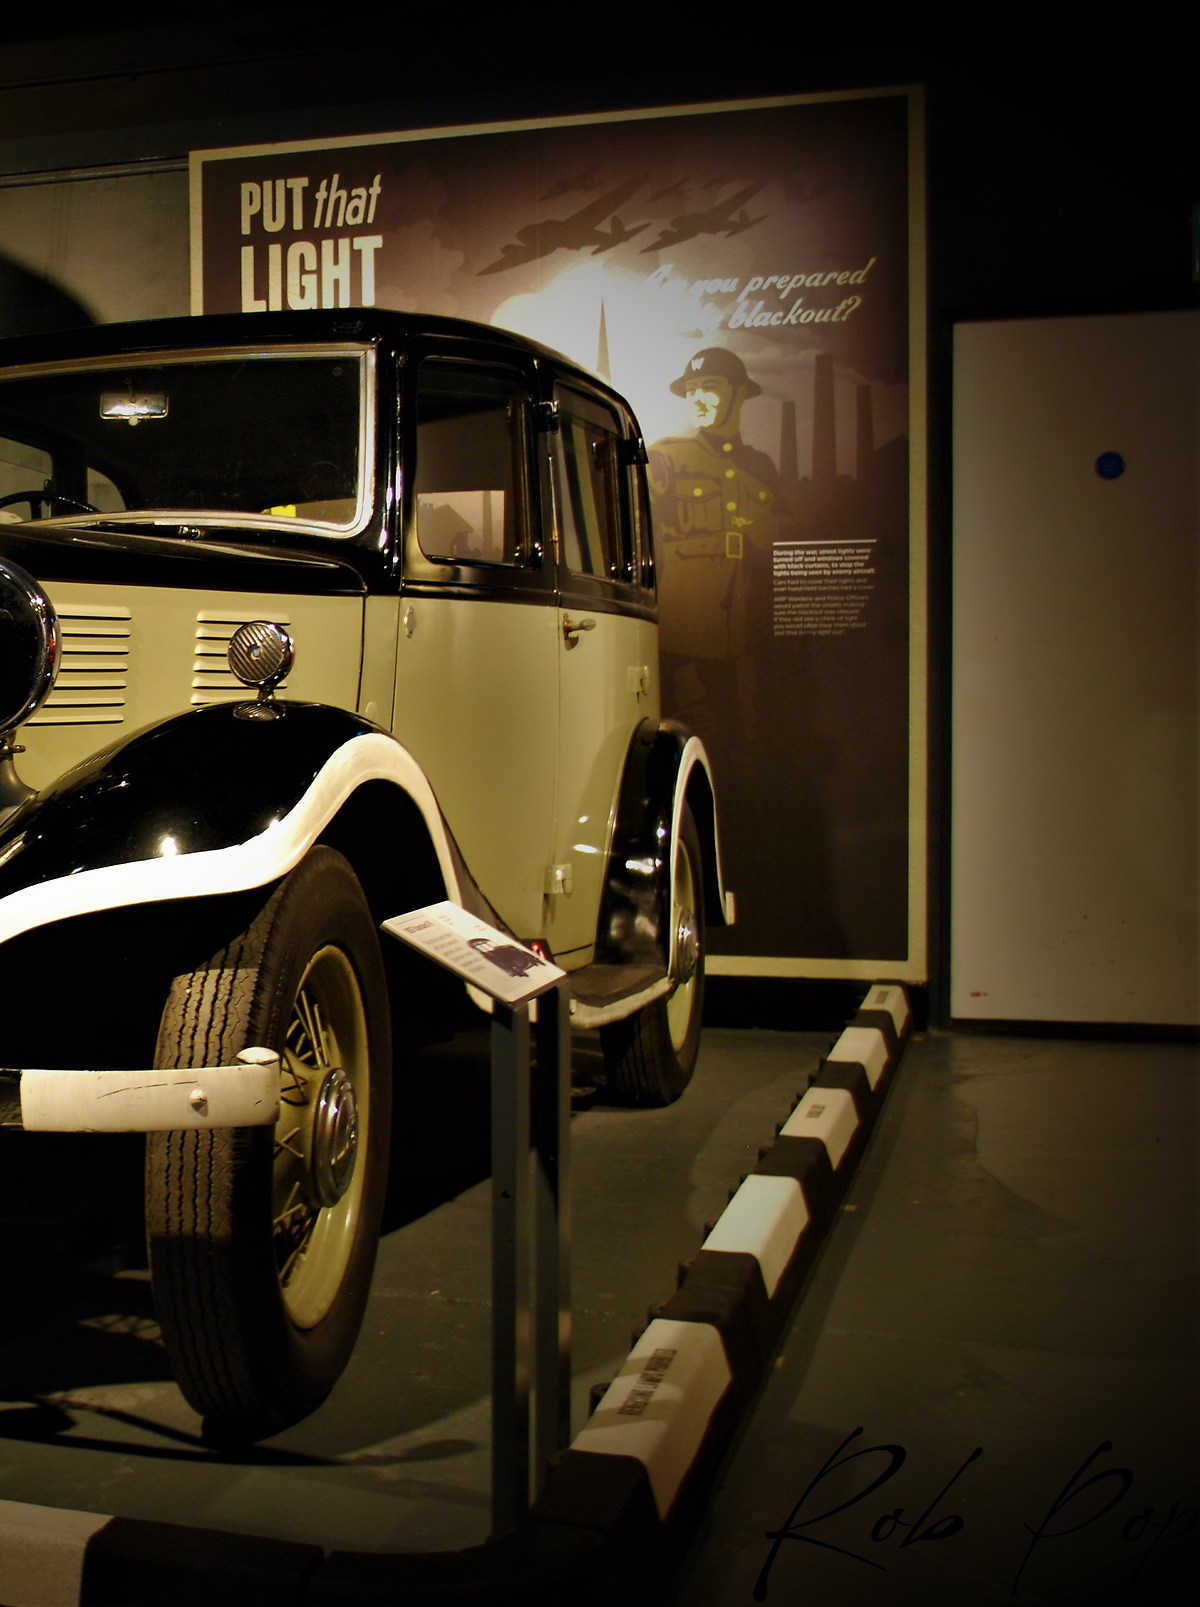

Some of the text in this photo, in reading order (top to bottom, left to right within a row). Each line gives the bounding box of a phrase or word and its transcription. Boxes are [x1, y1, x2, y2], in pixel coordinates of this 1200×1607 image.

[240, 173, 382, 236] PUT that
[240, 235, 383, 313] LIGHT
[689, 278, 739, 303] you
[737, 257, 876, 302] prepared
[728, 296, 862, 329] blackout?
